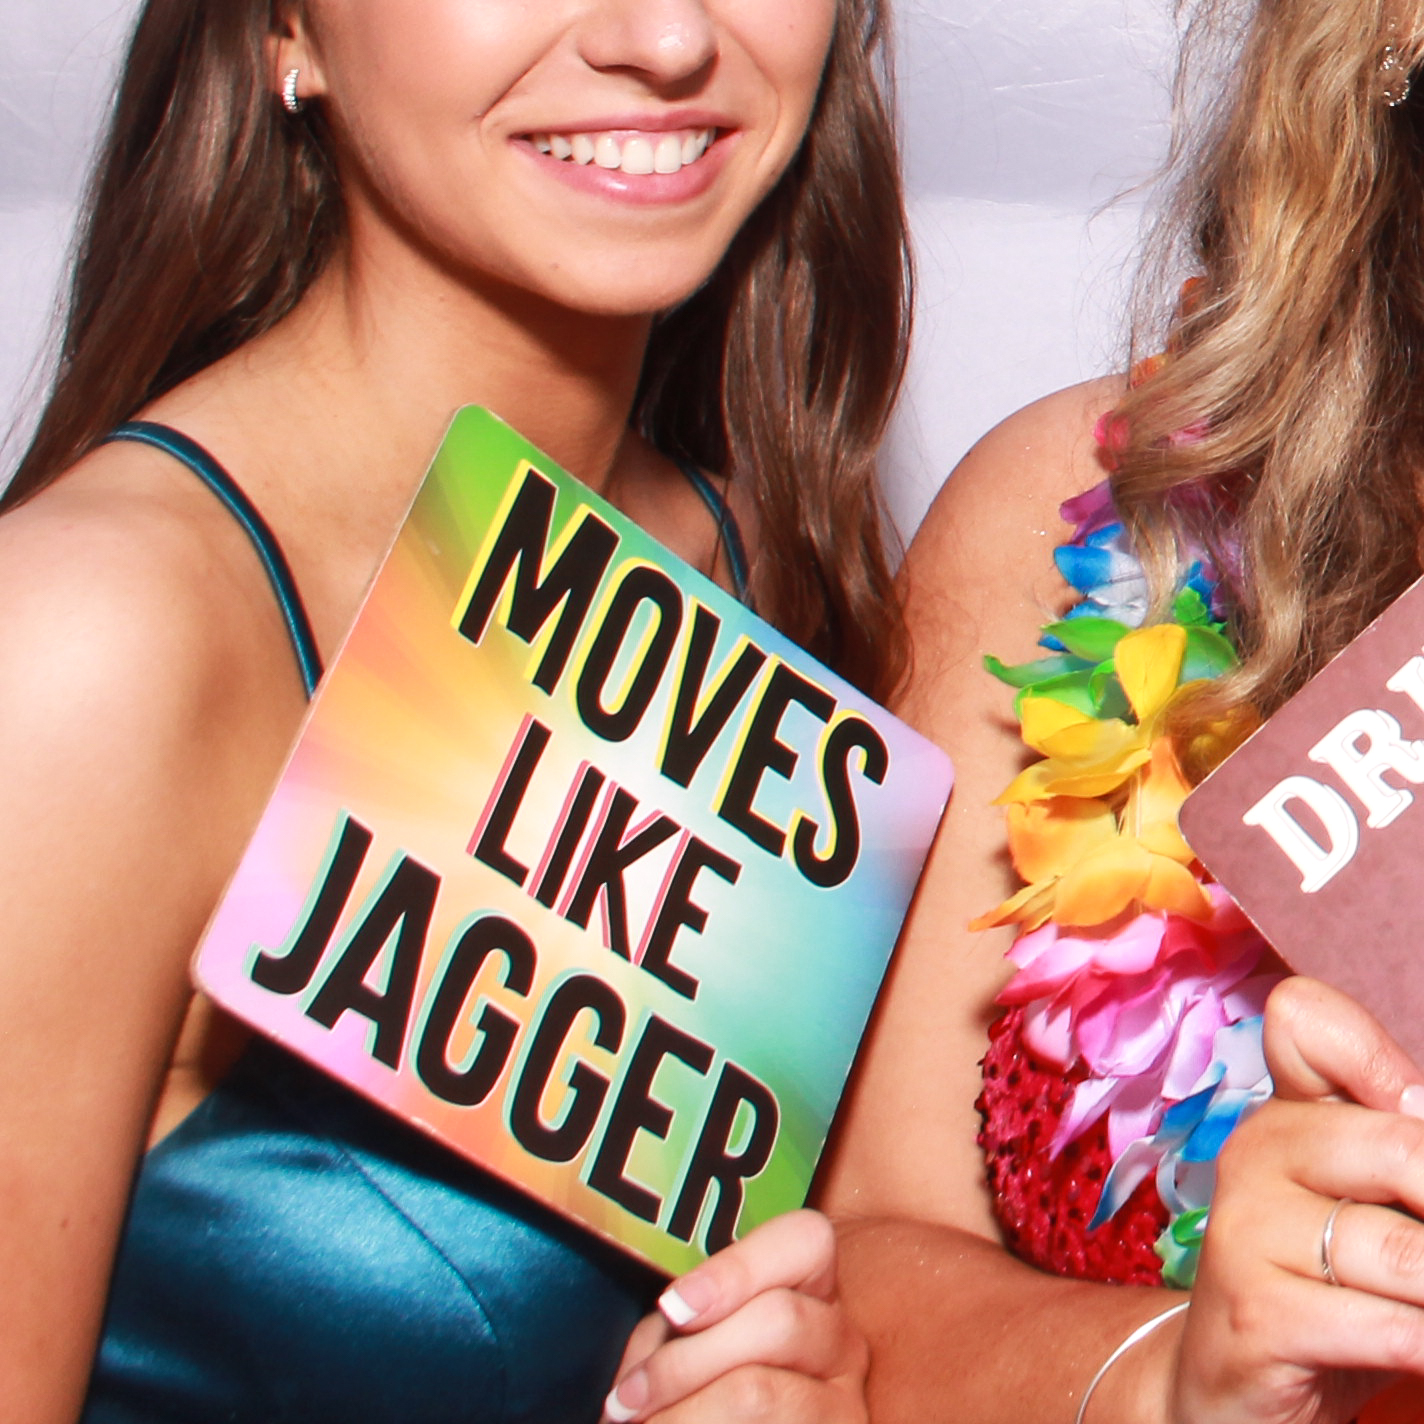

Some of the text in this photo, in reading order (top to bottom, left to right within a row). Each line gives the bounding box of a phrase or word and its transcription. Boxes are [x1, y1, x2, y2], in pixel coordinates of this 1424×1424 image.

[451, 458, 889, 891] MOVES
[466, 712, 742, 1002] LIKE
[242, 808, 781, 1258] JAGGER
